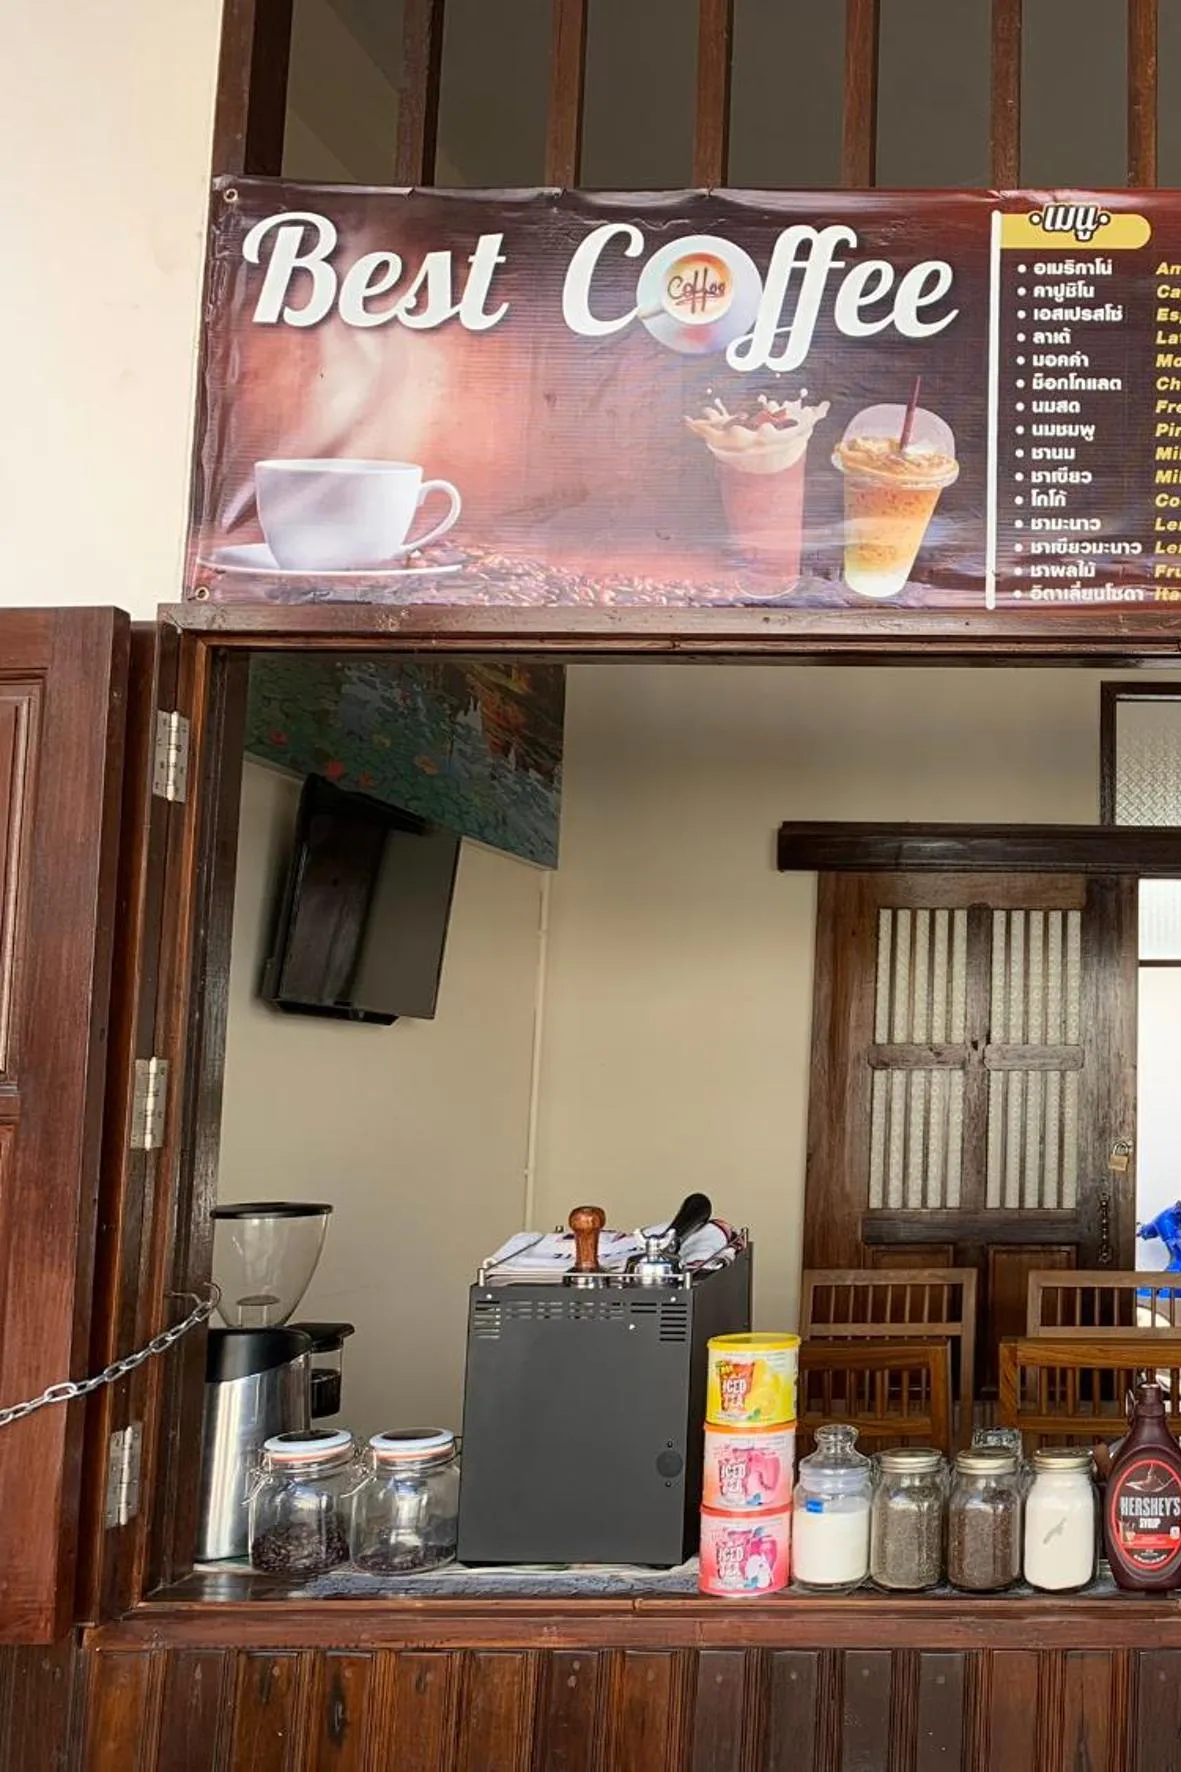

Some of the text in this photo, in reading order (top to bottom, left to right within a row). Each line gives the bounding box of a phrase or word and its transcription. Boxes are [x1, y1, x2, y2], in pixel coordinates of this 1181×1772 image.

[1043, 204, 1099, 241] เมนู
[1033, 258, 1113, 275] อเมริกาโน่
[243, 211, 958, 373] Best Coffee
[1033, 280, 1095, 303] คาปูชิโน
[1033, 303, 1123, 321] เอสเปรสโซ่
[1032, 327, 1071, 344] ลาเต้
[1032, 350, 1089, 367] มอคค่า
[1032, 400, 1081, 413] นมสด
[1032, 423, 1096, 442] นมชมพู
[1031, 447, 1076, 460] ชานม
[1031, 466, 1093, 484] ชาเขียว
[1031, 489, 1068, 507] โกโก้
[1031, 518, 1102, 531] ชามะนาว
[1030, 537, 1143, 554] ชาเขียวมะนาว
[1030, 560, 1097, 578] ชาผลไม้
[722, 1378, 747, 1393] ICED
[1120, 1496, 1181, 1516] HERSHEY'S
